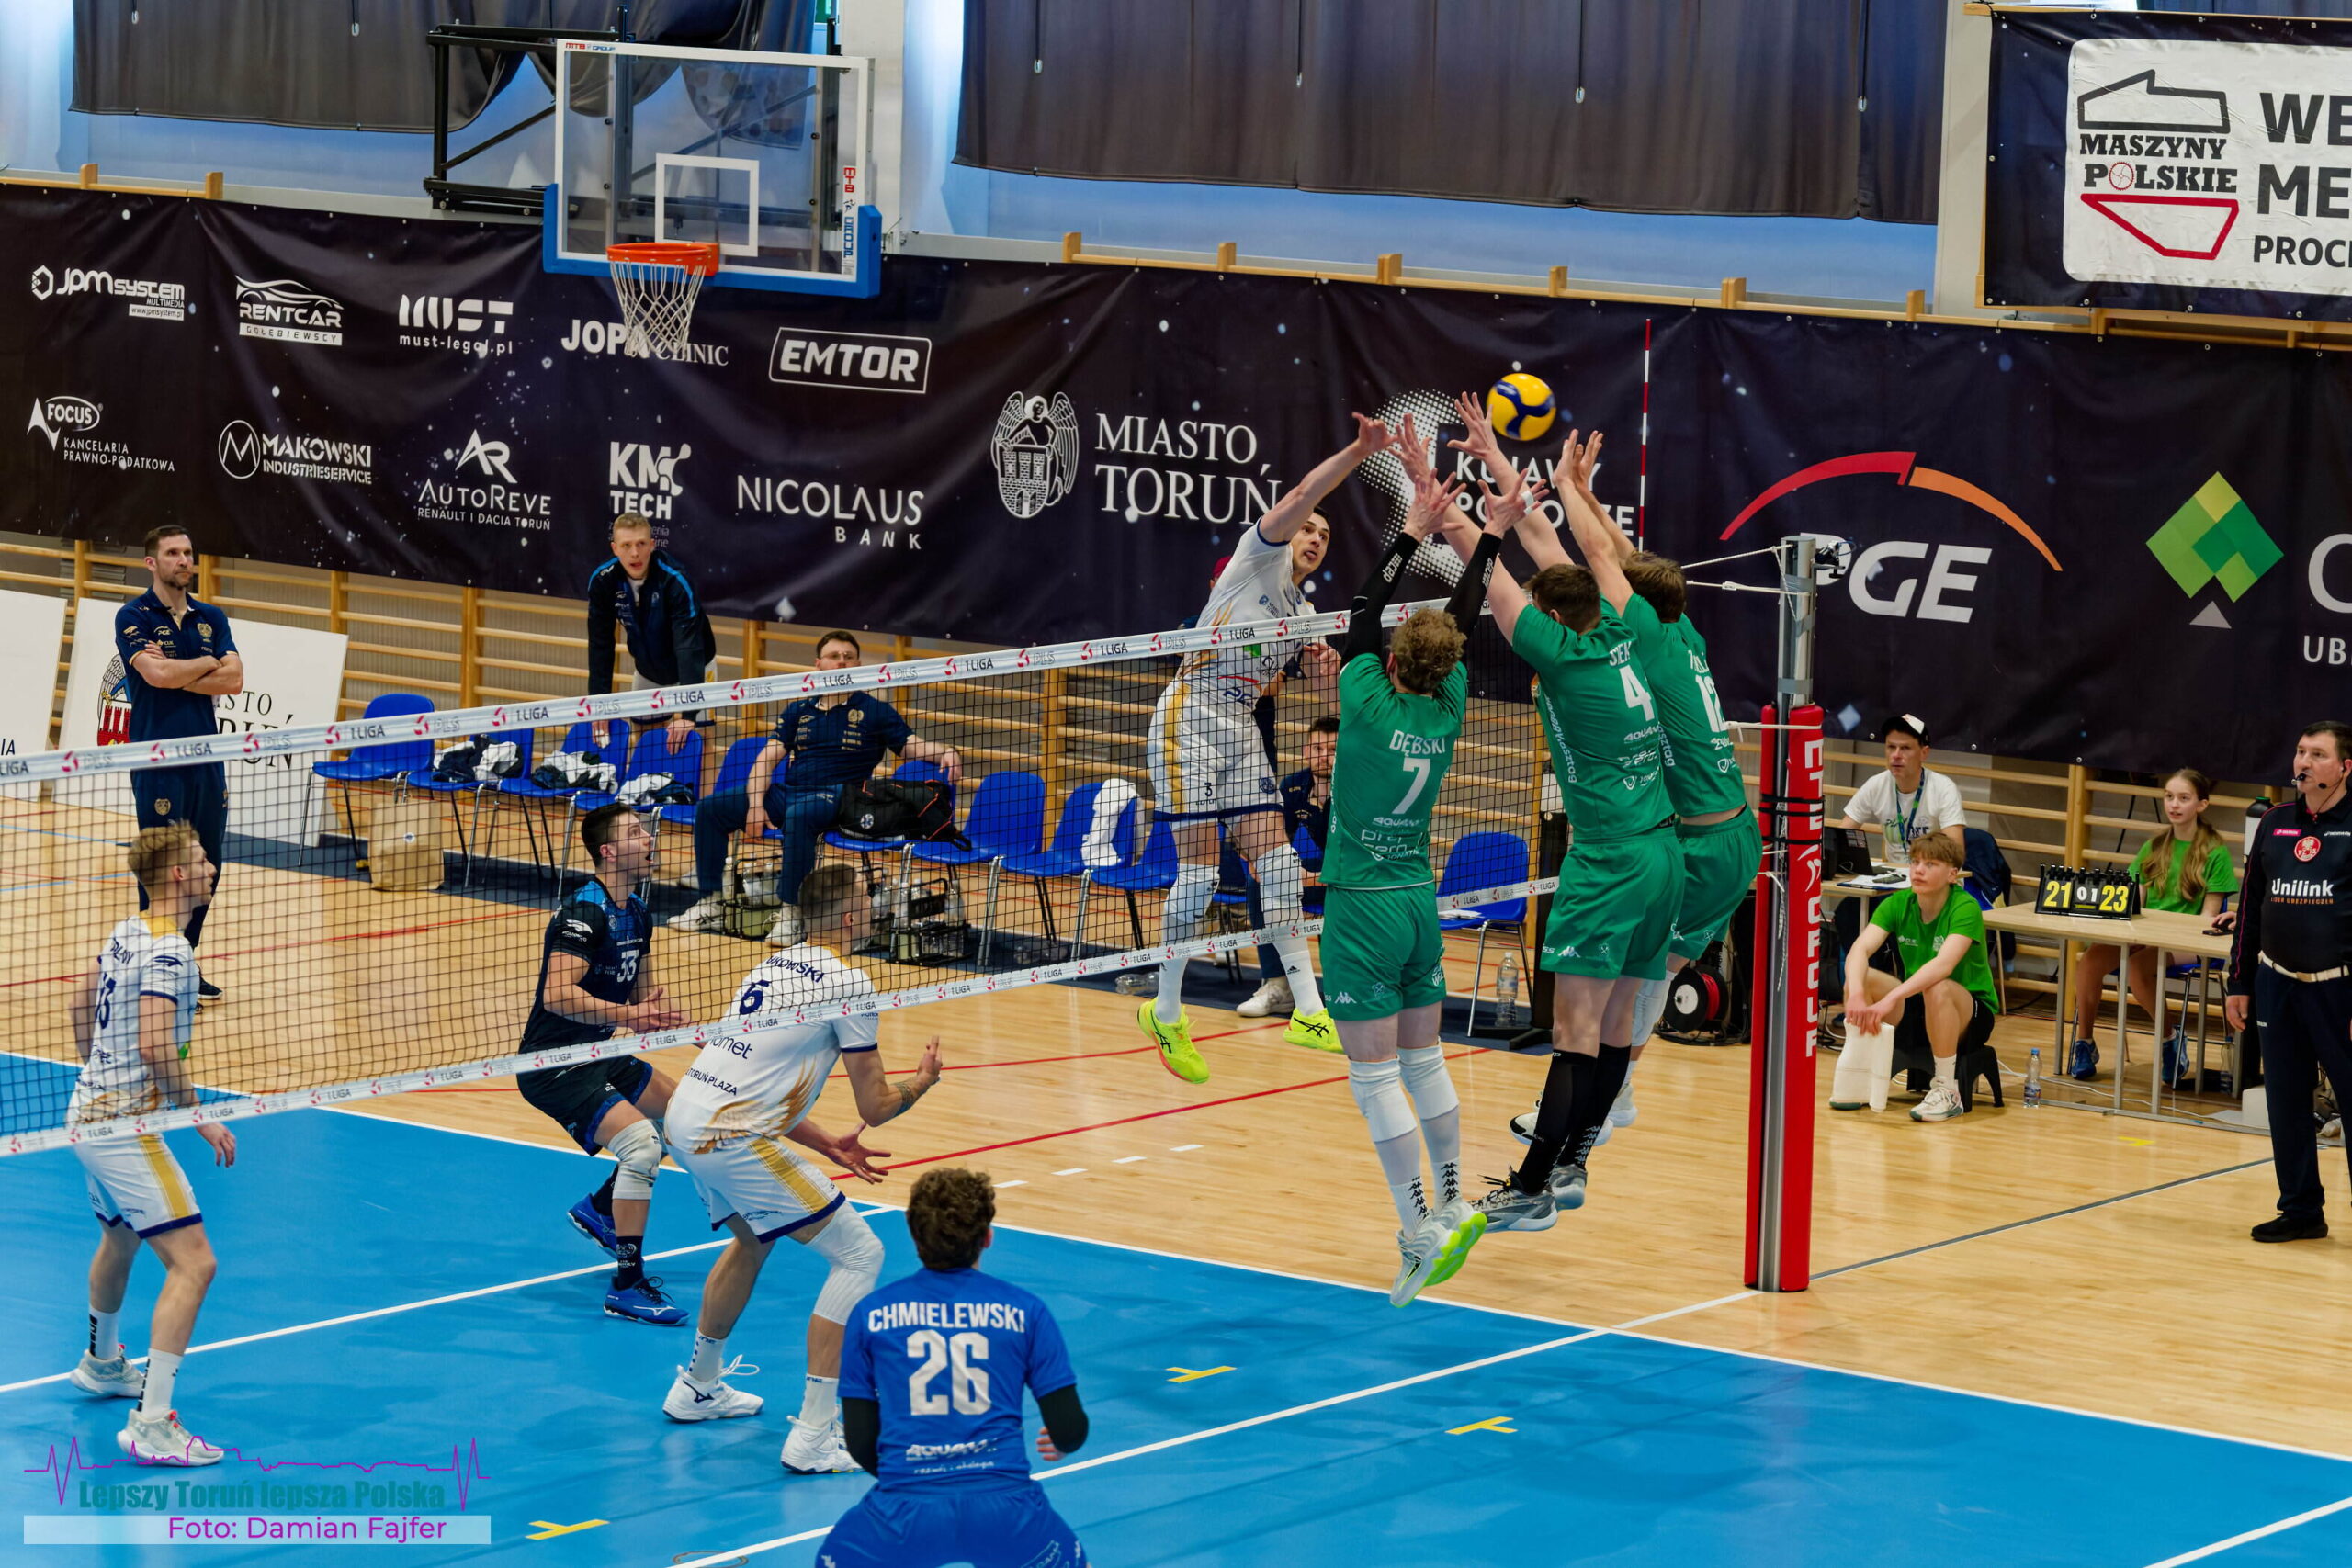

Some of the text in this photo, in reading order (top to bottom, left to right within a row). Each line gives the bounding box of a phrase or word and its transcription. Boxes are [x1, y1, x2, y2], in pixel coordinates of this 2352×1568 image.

[2079, 134, 2226, 159] MASZYNY
[2084, 162, 2237, 193] POLSKIE
[2253, 235, 2352, 267] PROC
[146, 298, 185, 309] MULTIMEDIA
[239, 303, 342, 328] RENTCAR
[400, 334, 513, 355] must-legal.pl
[780, 340, 920, 381] EMTOR
[47, 403, 92, 425] FOCUS
[63, 437, 129, 455] KANCELARIA
[263, 433, 371, 468] MAKOWSKI
[1095, 413, 1258, 464] MIASTO
[63, 450, 175, 472] PRAWNO-PODATKOWA
[263, 461, 371, 484] INDUSTRIESERVICE
[610, 491, 672, 520] TECH
[737, 475, 924, 525] NICOLAUS
[1095, 464, 1282, 525] TORUŃ
[418, 507, 466, 523] RENAULT
[478, 513, 511, 527] DACIA
[835, 526, 921, 550] BANK
[2303, 635, 2352, 665] UB
[1619, 665, 1655, 722] 4
[1389, 729, 1445, 757] DĘBSKI
[1392, 758, 1430, 815] 7
[2043, 881, 2071, 908] 21
[2099, 885, 2129, 912] 23
[2271, 878, 2334, 897] Unilink
[616, 949, 639, 982] 33
[740, 980, 771, 1015] 6
[709, 1075, 737, 1096] PLAZA
[868, 1301, 1025, 1333] CHMIELEWSKI
[906, 1329, 991, 1416] 26
